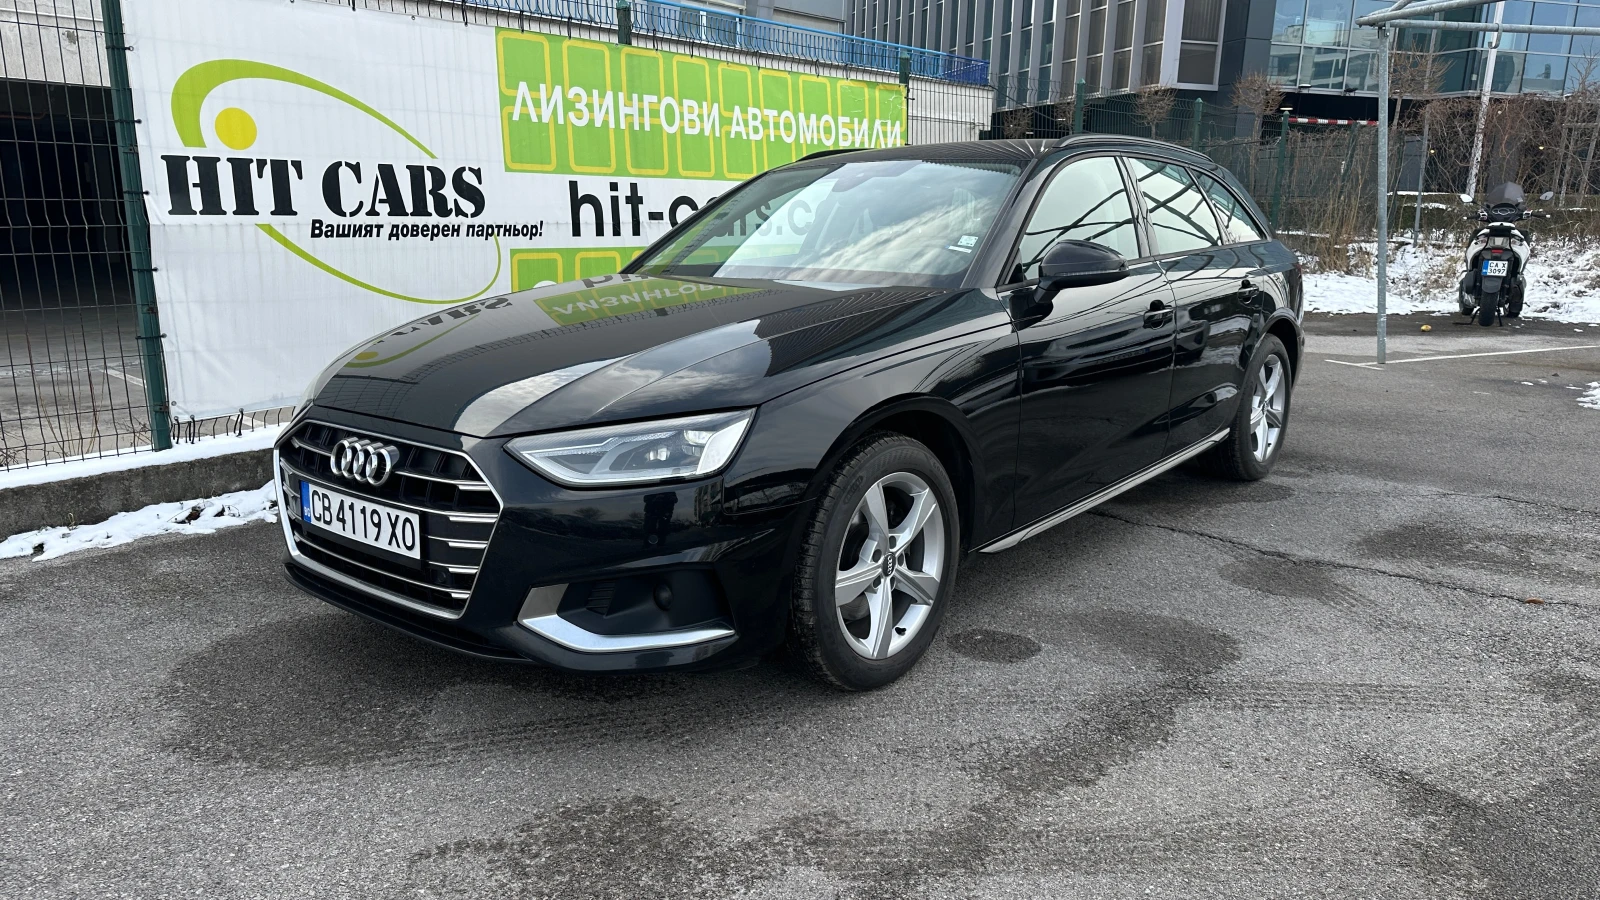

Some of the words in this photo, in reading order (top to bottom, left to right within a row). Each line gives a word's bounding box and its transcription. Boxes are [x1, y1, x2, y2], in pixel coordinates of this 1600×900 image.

[511, 81, 721, 138] ЛИЗИНГОВИ
[729, 105, 901, 149] АВТОМОБИЛИ
[160, 154, 303, 216] HIT
[322, 160, 486, 218] CARS
[310, 218, 384, 239] Вашият
[387, 222, 461, 241] доверен
[465, 220, 544, 241] партньор!
